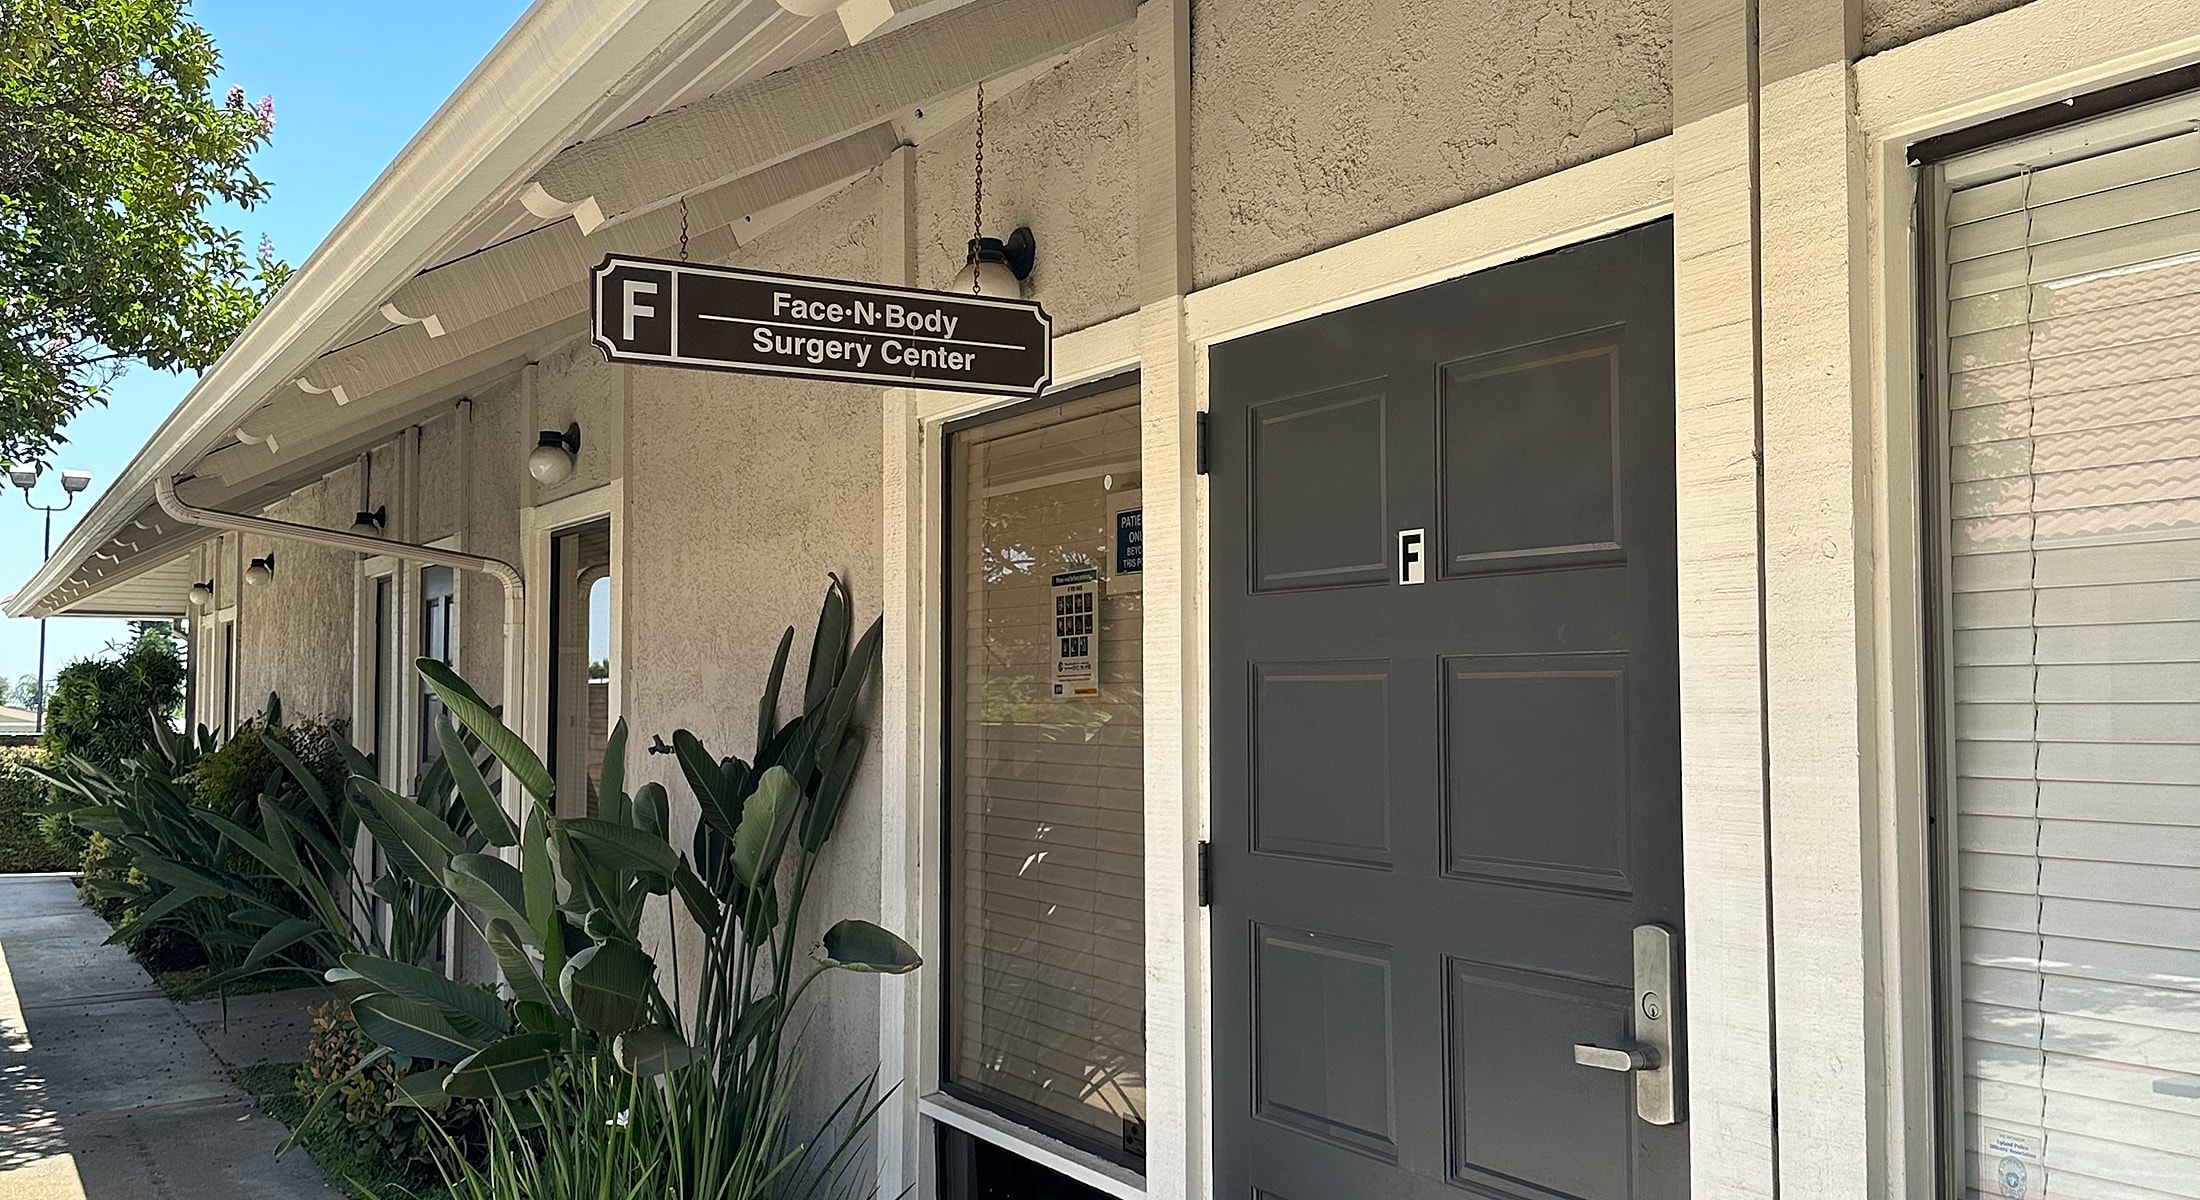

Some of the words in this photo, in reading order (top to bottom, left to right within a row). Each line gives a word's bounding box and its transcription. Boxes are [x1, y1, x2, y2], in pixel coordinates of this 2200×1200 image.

[622, 279, 658, 341] F
[752, 327, 872, 368] Surgery
[880, 340, 976, 372] Center
[1121, 514, 1142, 529] PATIE
[1128, 530, 1142, 543] ONL
[1402, 533, 1421, 582] F
